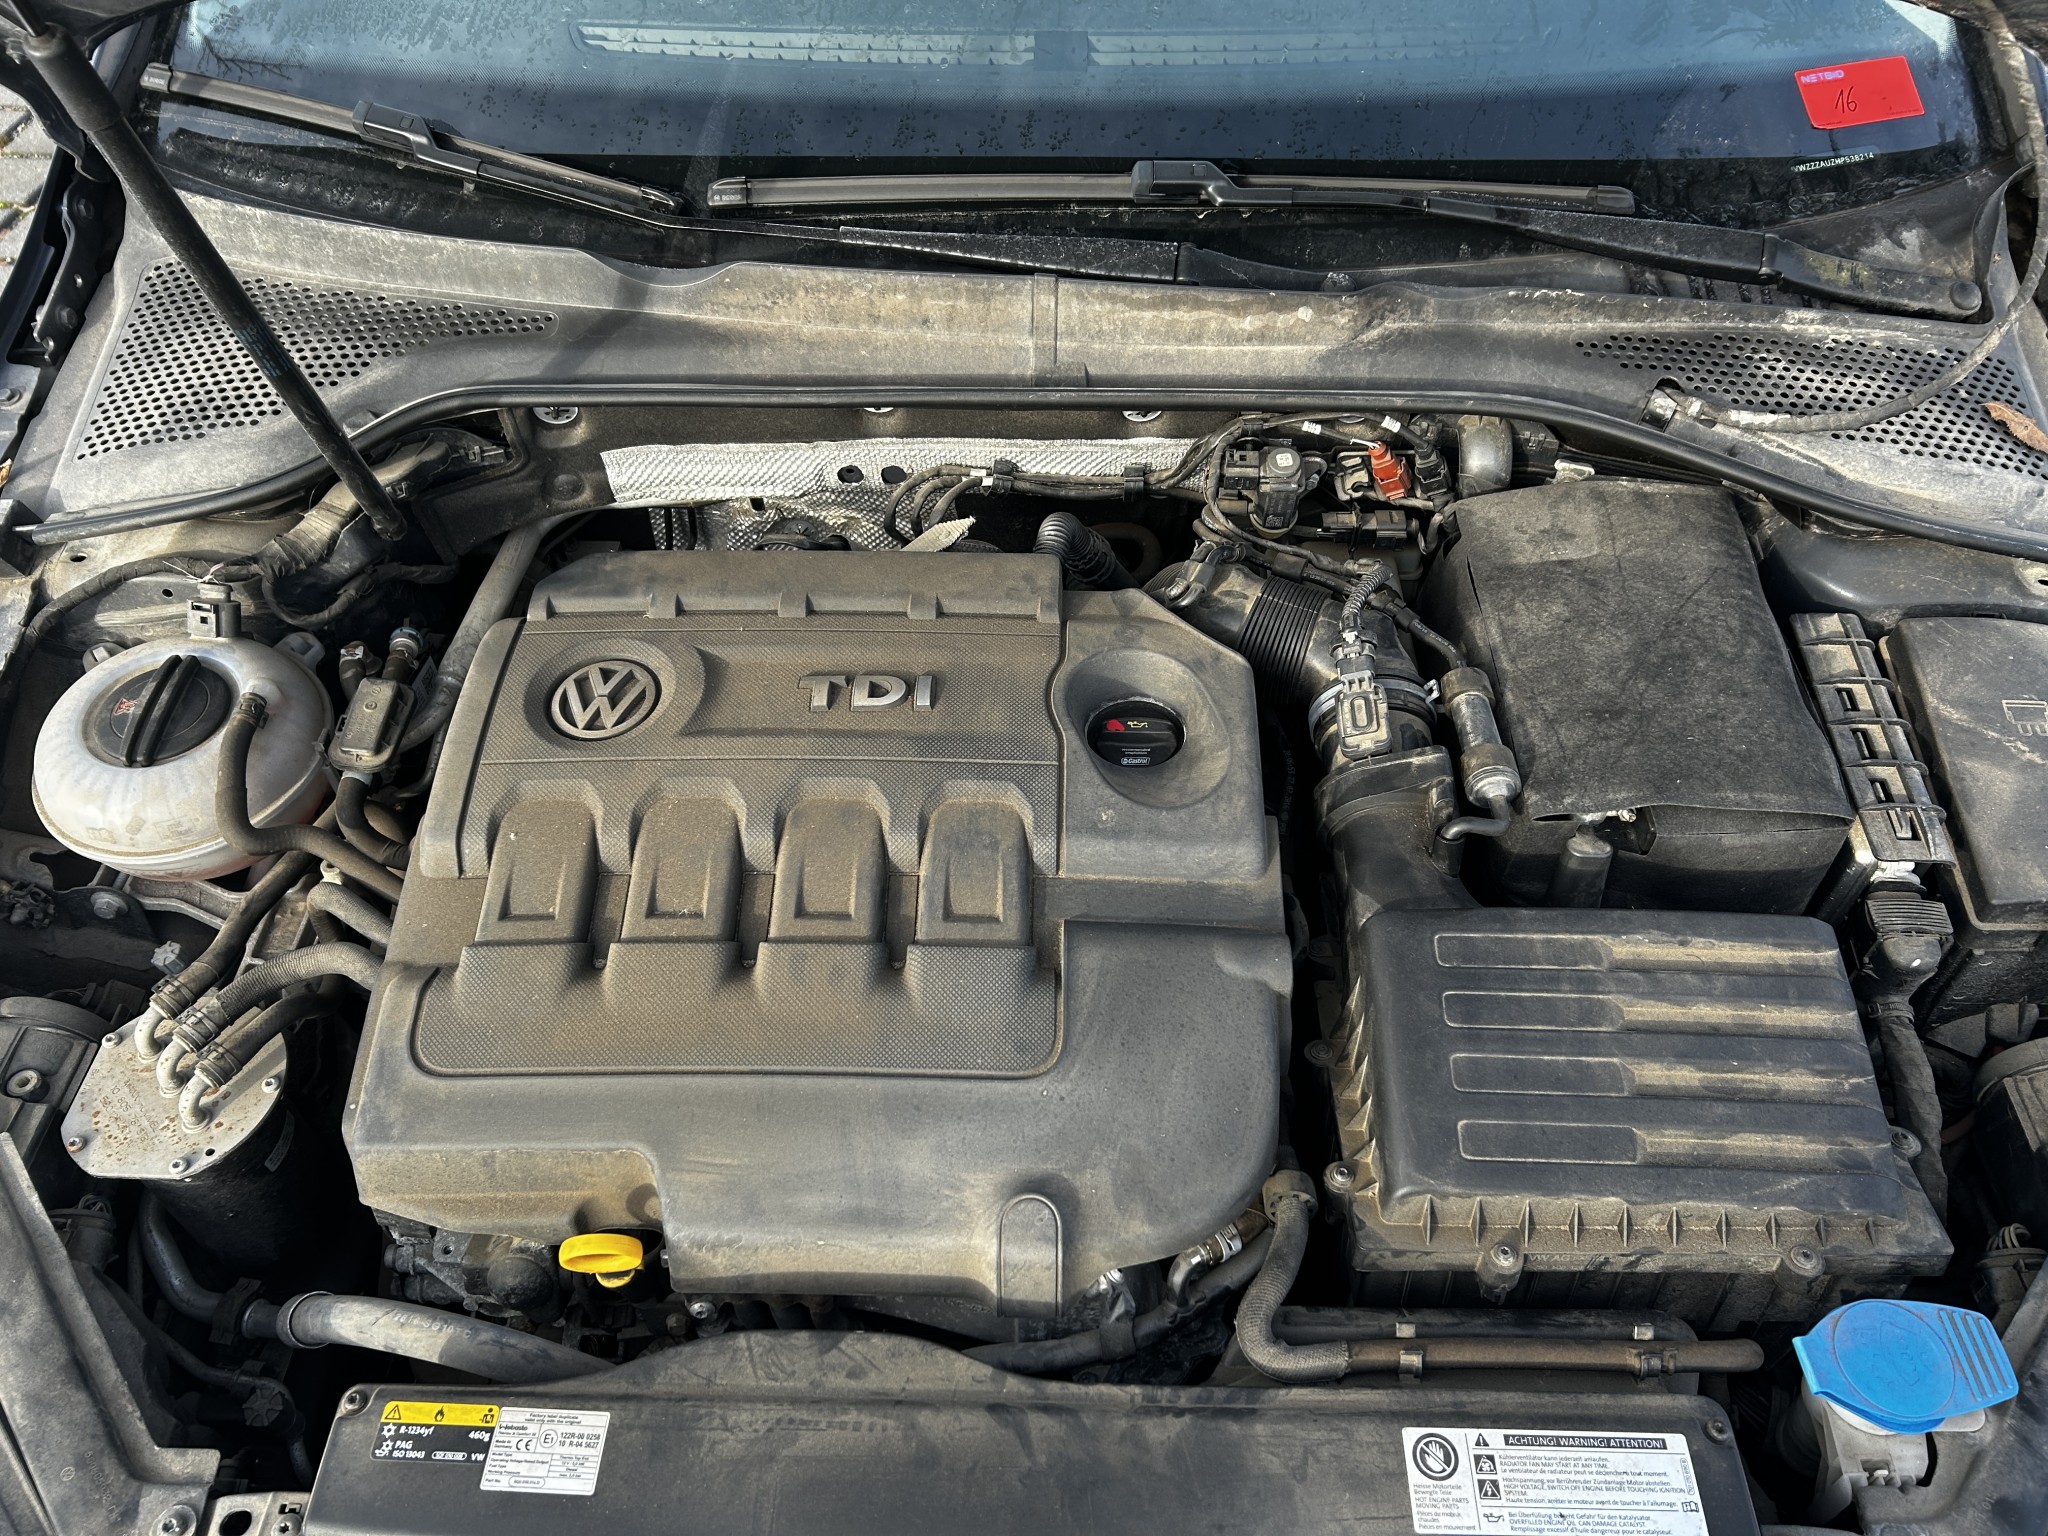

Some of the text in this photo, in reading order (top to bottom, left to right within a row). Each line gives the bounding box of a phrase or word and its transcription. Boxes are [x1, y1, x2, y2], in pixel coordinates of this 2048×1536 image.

[1800, 69, 1845, 84] NETBID
[1835, 86, 1857, 113] 16
[799, 674, 938, 712] TDI
[399, 1425, 491, 1442] R-1234yf 460g
[394, 1440, 413, 1449] PAG
[1508, 1436, 1664, 1449] ACHTUNG! WARNING! ATTENTION!
[392, 1450, 405, 1458] ISO
[471, 1453, 486, 1461] VW
[1590, 1527, 1620, 1535] dangereux
